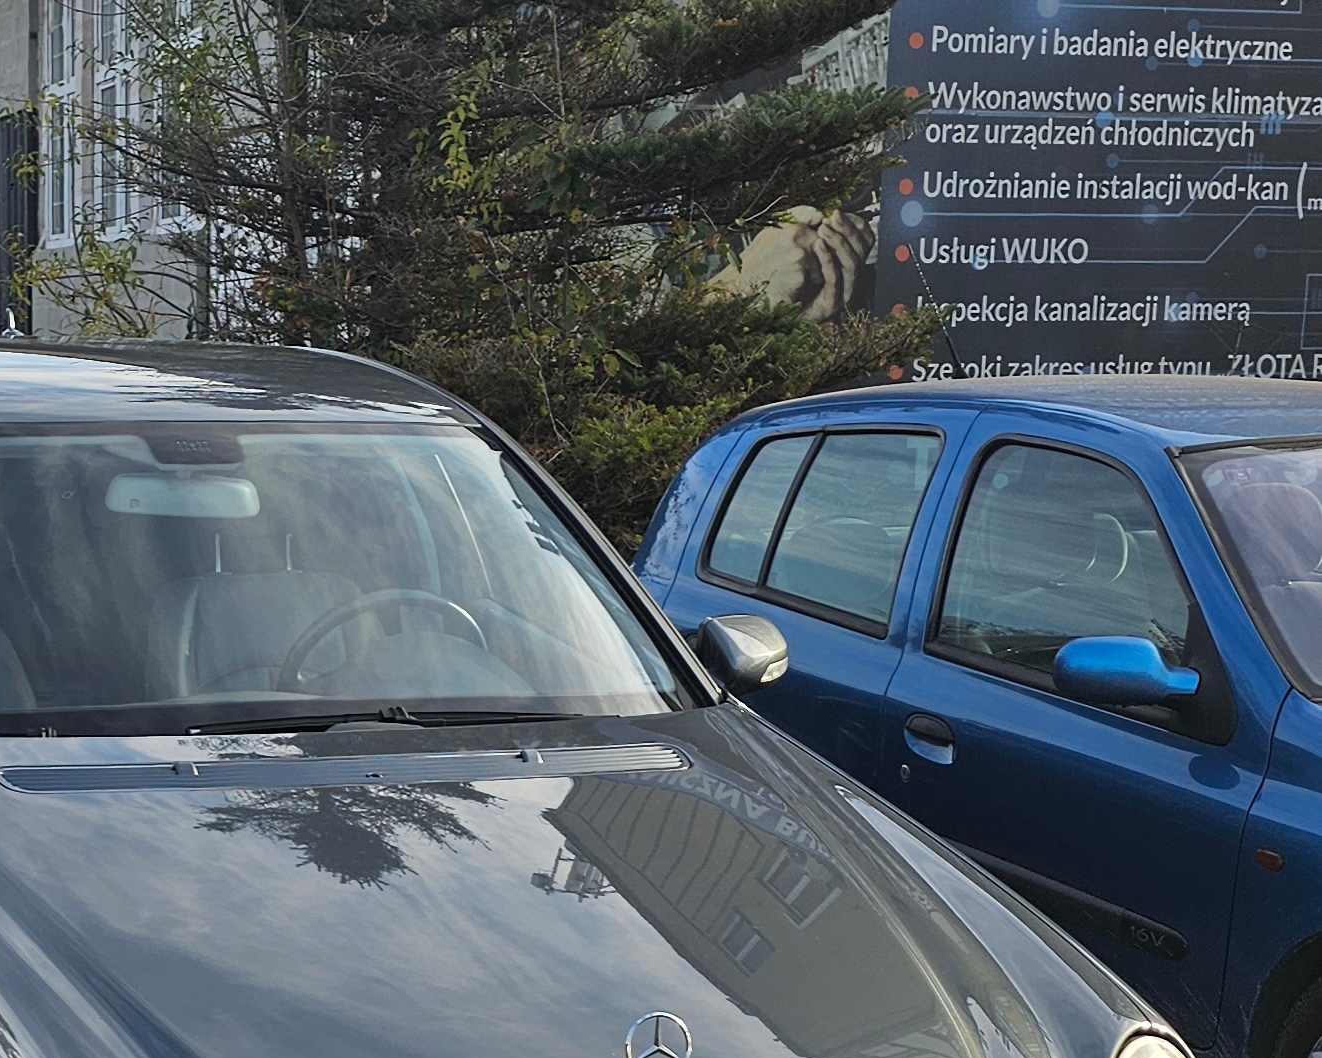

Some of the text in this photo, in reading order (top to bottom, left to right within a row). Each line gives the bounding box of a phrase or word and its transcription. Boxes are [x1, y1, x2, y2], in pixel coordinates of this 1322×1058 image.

[931, 25, 1293, 65] Pomiary i badania elektryczne
[928, 82, 1112, 114] Wykonawstwo
[1117, 85, 1125, 112] i
[1129, 87, 1205, 114] serwis
[925, 117, 1255, 152] oraz urządzeń chłodniczych
[923, 171, 1071, 198] Udrożnianie
[1076, 172, 1182, 206] instalacji
[1187, 173, 1289, 201] wod-kan
[919, 237, 1089, 271] Usługi WUKO
[916, 295, 1251, 328] Ipekcja kanalizacji kamerą
[911, 354, 1003, 382] Szeoki
[1007, 354, 1084, 376] zakres
[1130, 925, 1165, 947] 16V
